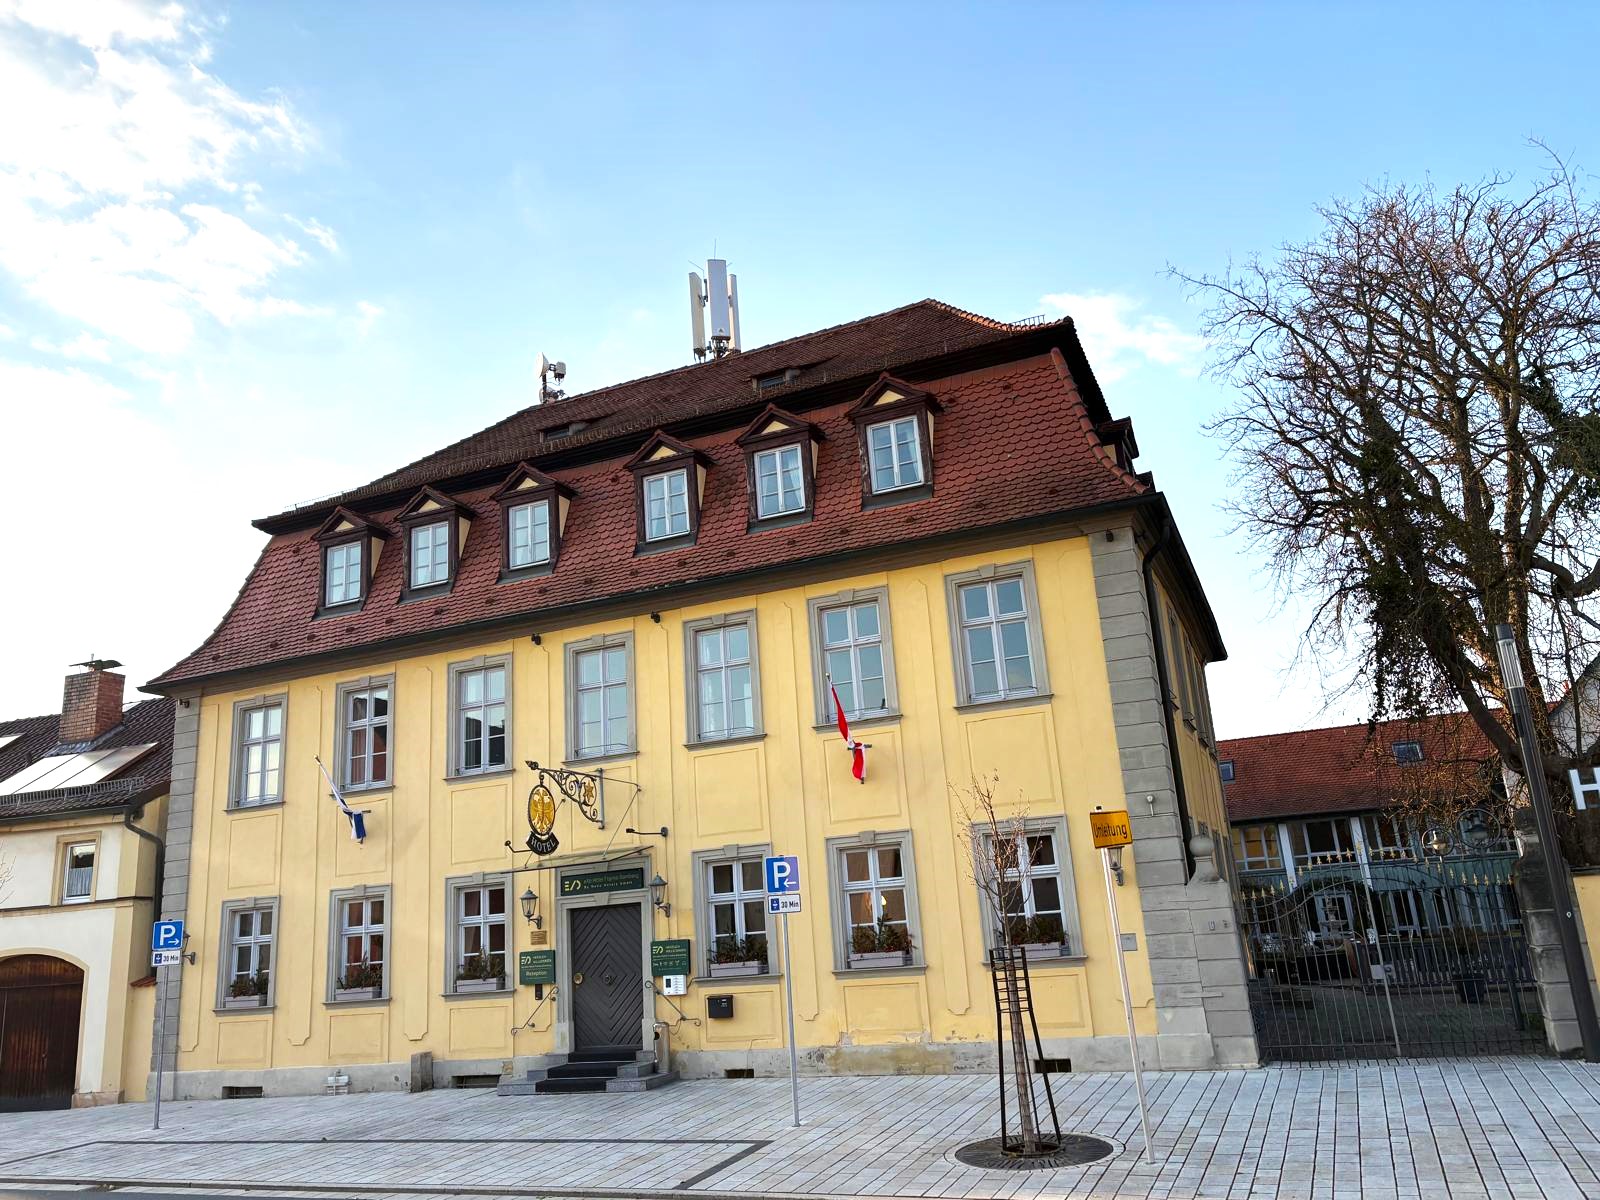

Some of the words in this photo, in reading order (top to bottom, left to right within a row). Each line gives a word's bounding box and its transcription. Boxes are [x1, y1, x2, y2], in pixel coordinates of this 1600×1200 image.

[1094, 823, 1128, 839] Umleitung
[531, 837, 556, 852] HOTEL
[772, 861, 791, 889] P
[781, 901, 788, 909] 30
[159, 924, 176, 946] P
